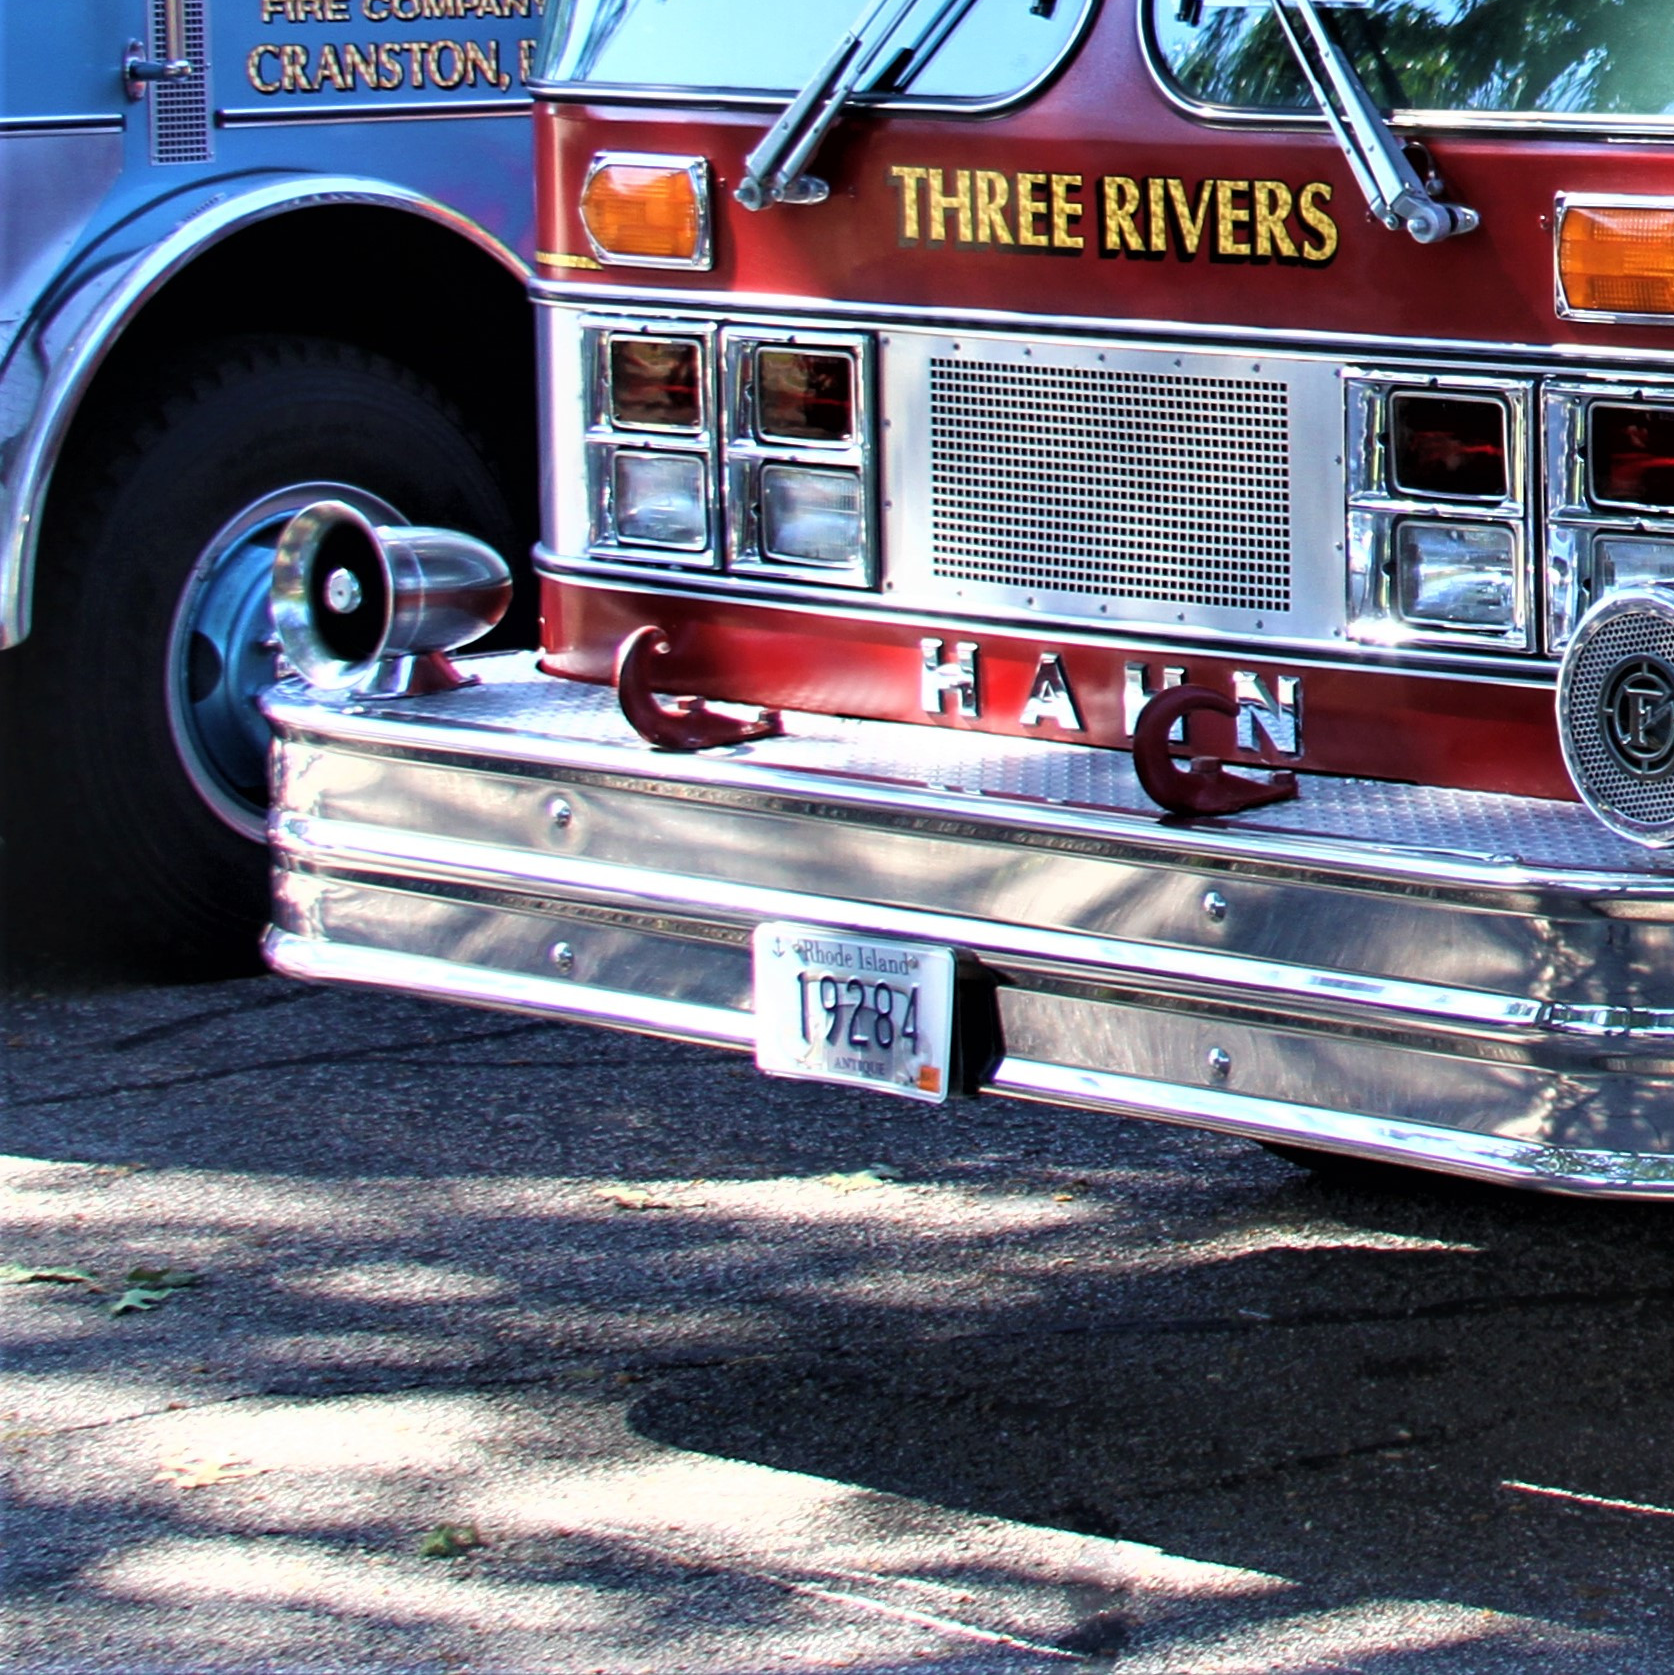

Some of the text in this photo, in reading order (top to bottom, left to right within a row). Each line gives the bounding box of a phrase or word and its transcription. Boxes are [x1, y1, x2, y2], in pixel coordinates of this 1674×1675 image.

[246, 39, 511, 93] CRANSTON,
[890, 164, 1341, 264] THREE RIVERS
[919, 637, 1304, 759] HAHN
[803, 938, 910, 976] Rhode Island
[796, 969, 921, 1056] 19284
[834, 1055, 886, 1075] ANTIQUE
